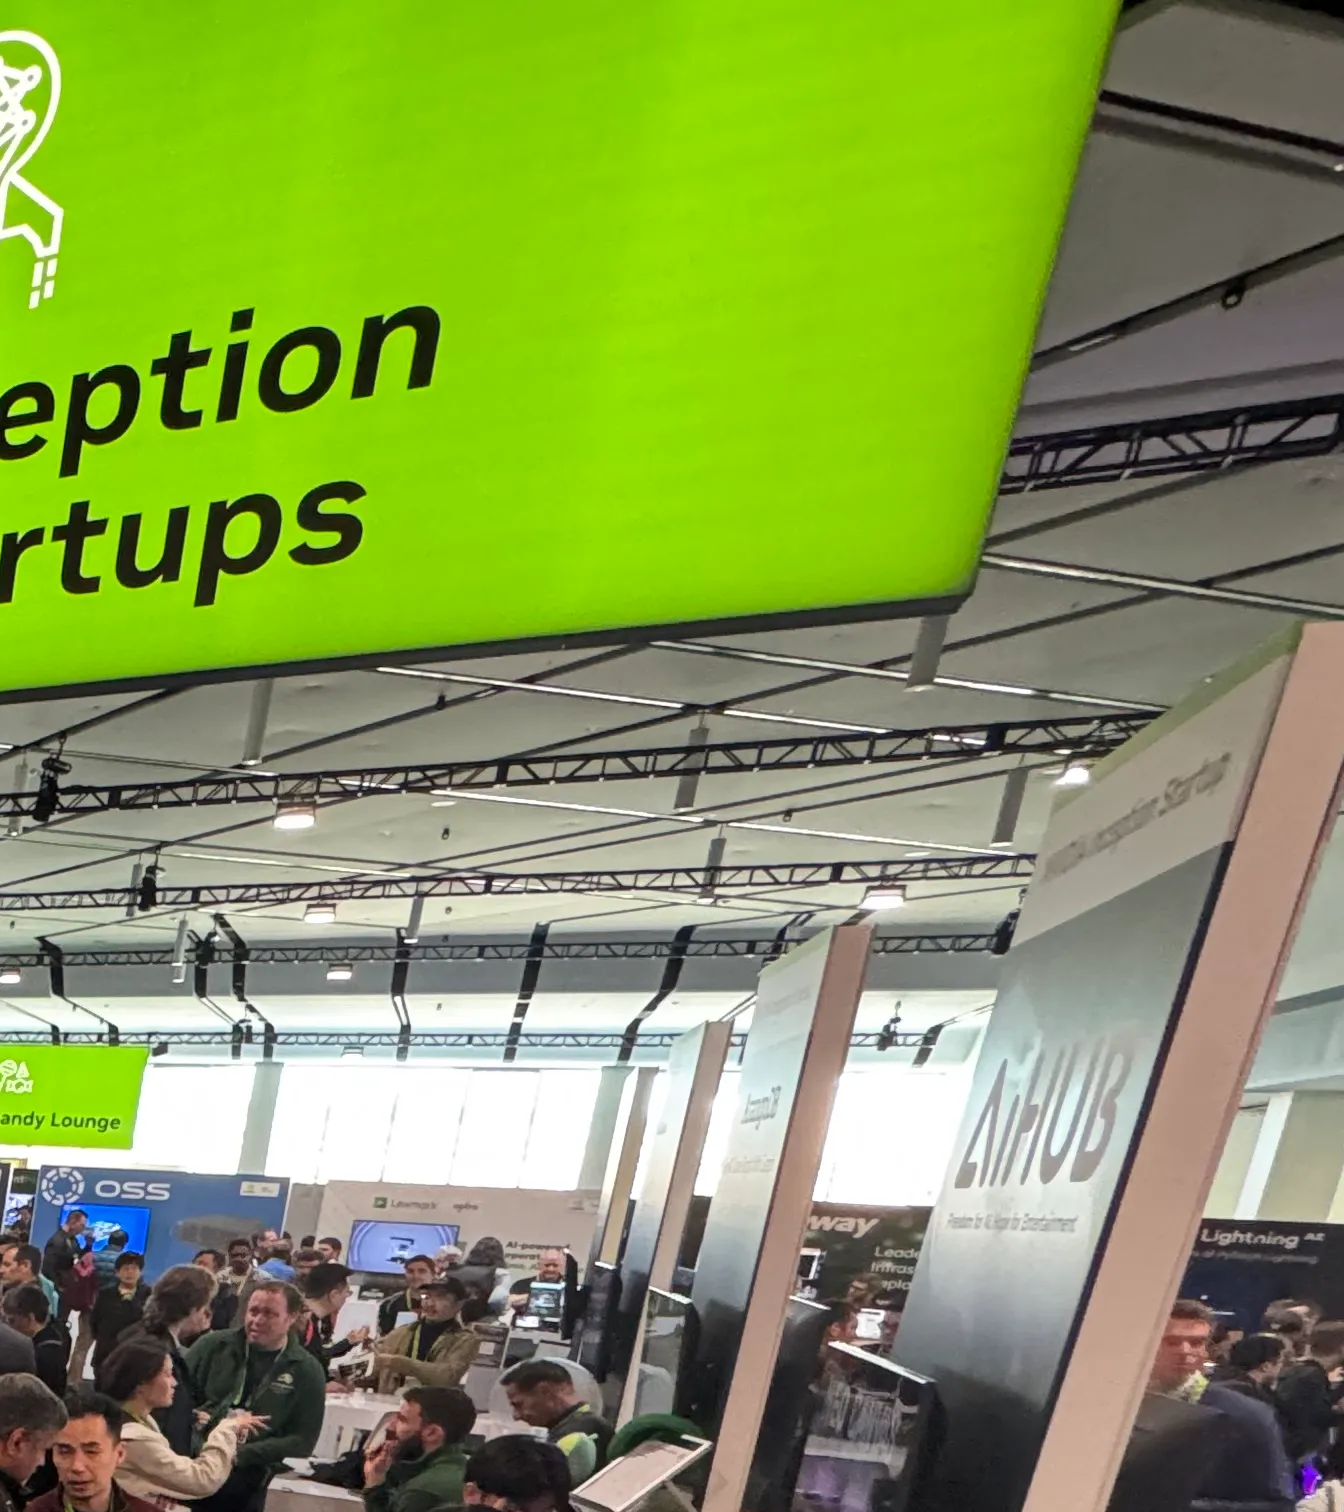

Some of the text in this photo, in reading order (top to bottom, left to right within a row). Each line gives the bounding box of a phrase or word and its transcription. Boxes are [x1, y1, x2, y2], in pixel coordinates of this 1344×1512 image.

[51, 1112, 121, 1133] Lounge
[95, 1180, 171, 1201] OSS
[1200, 1227, 1300, 1250] Lightning
